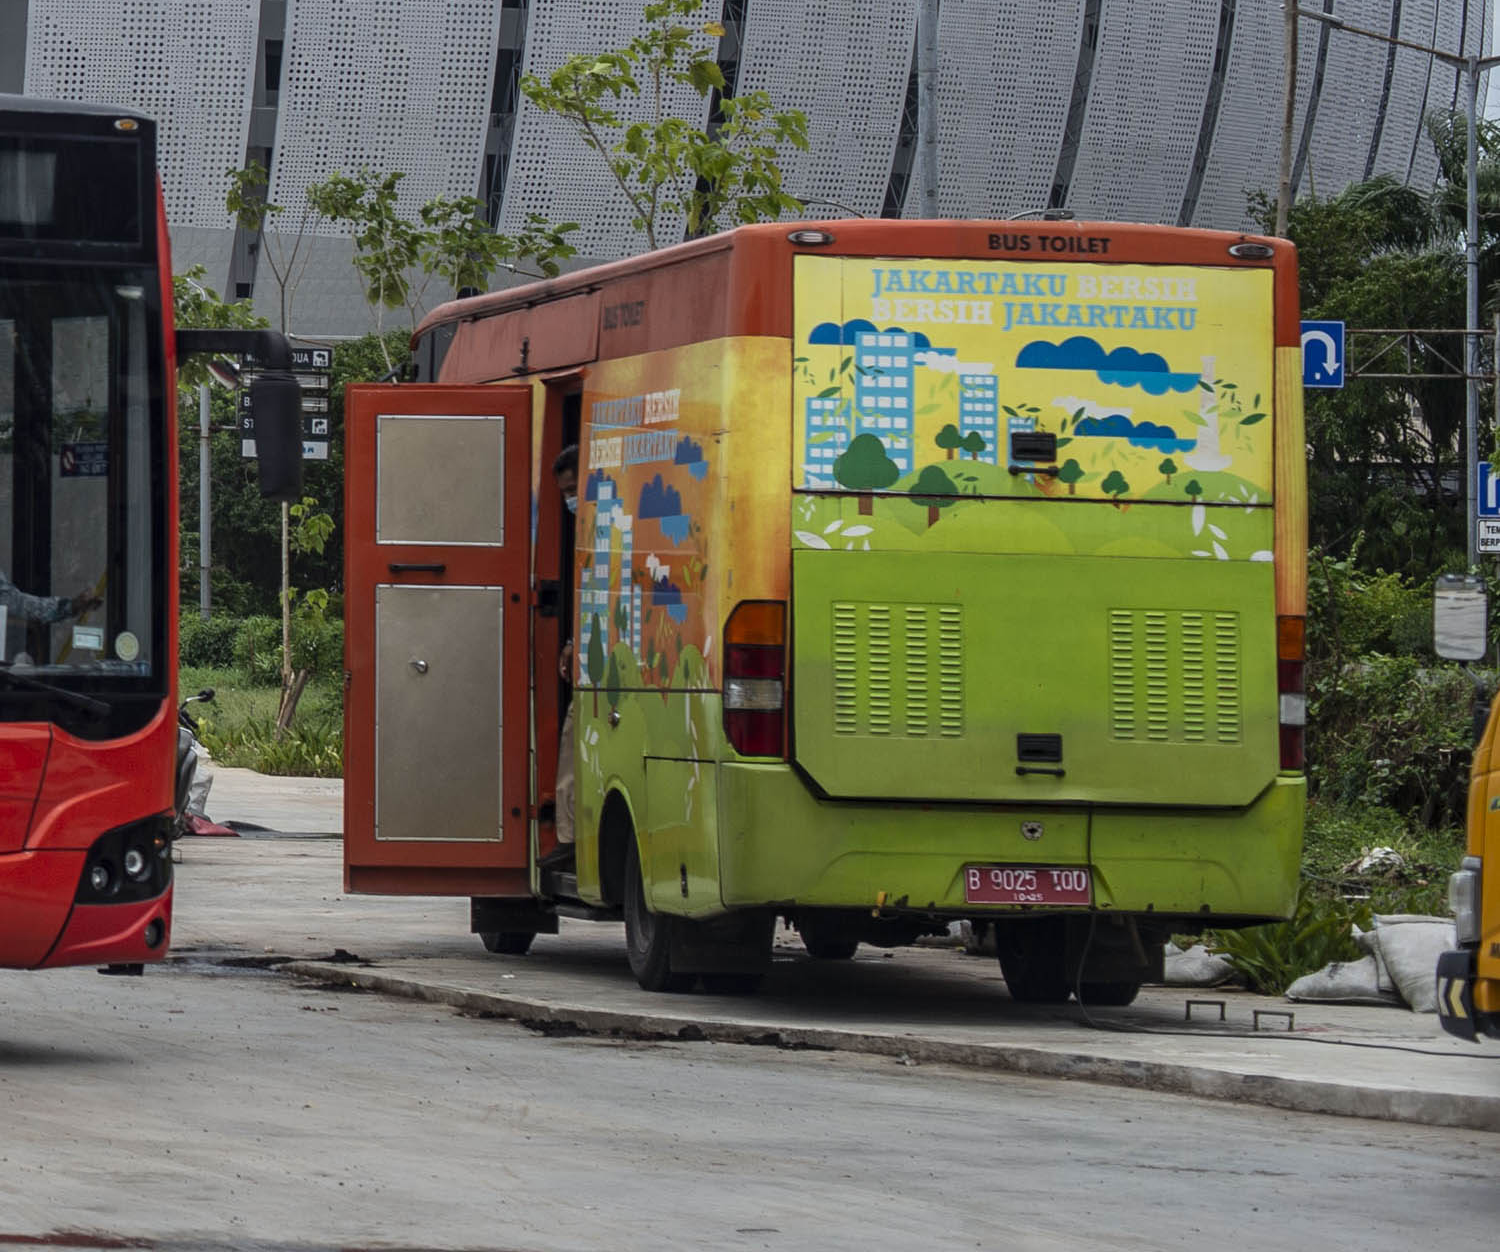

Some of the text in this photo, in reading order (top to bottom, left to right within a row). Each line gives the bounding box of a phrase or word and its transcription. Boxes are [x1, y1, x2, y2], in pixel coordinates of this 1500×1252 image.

[988, 233, 1112, 254] BUS TOILET
[871, 268, 1197, 301] JAKARTAKU BERSIH
[872, 297, 1197, 331] BERSIH JAKARTAKU
[968, 869, 981, 890] B
[991, 869, 1038, 891] 9025
